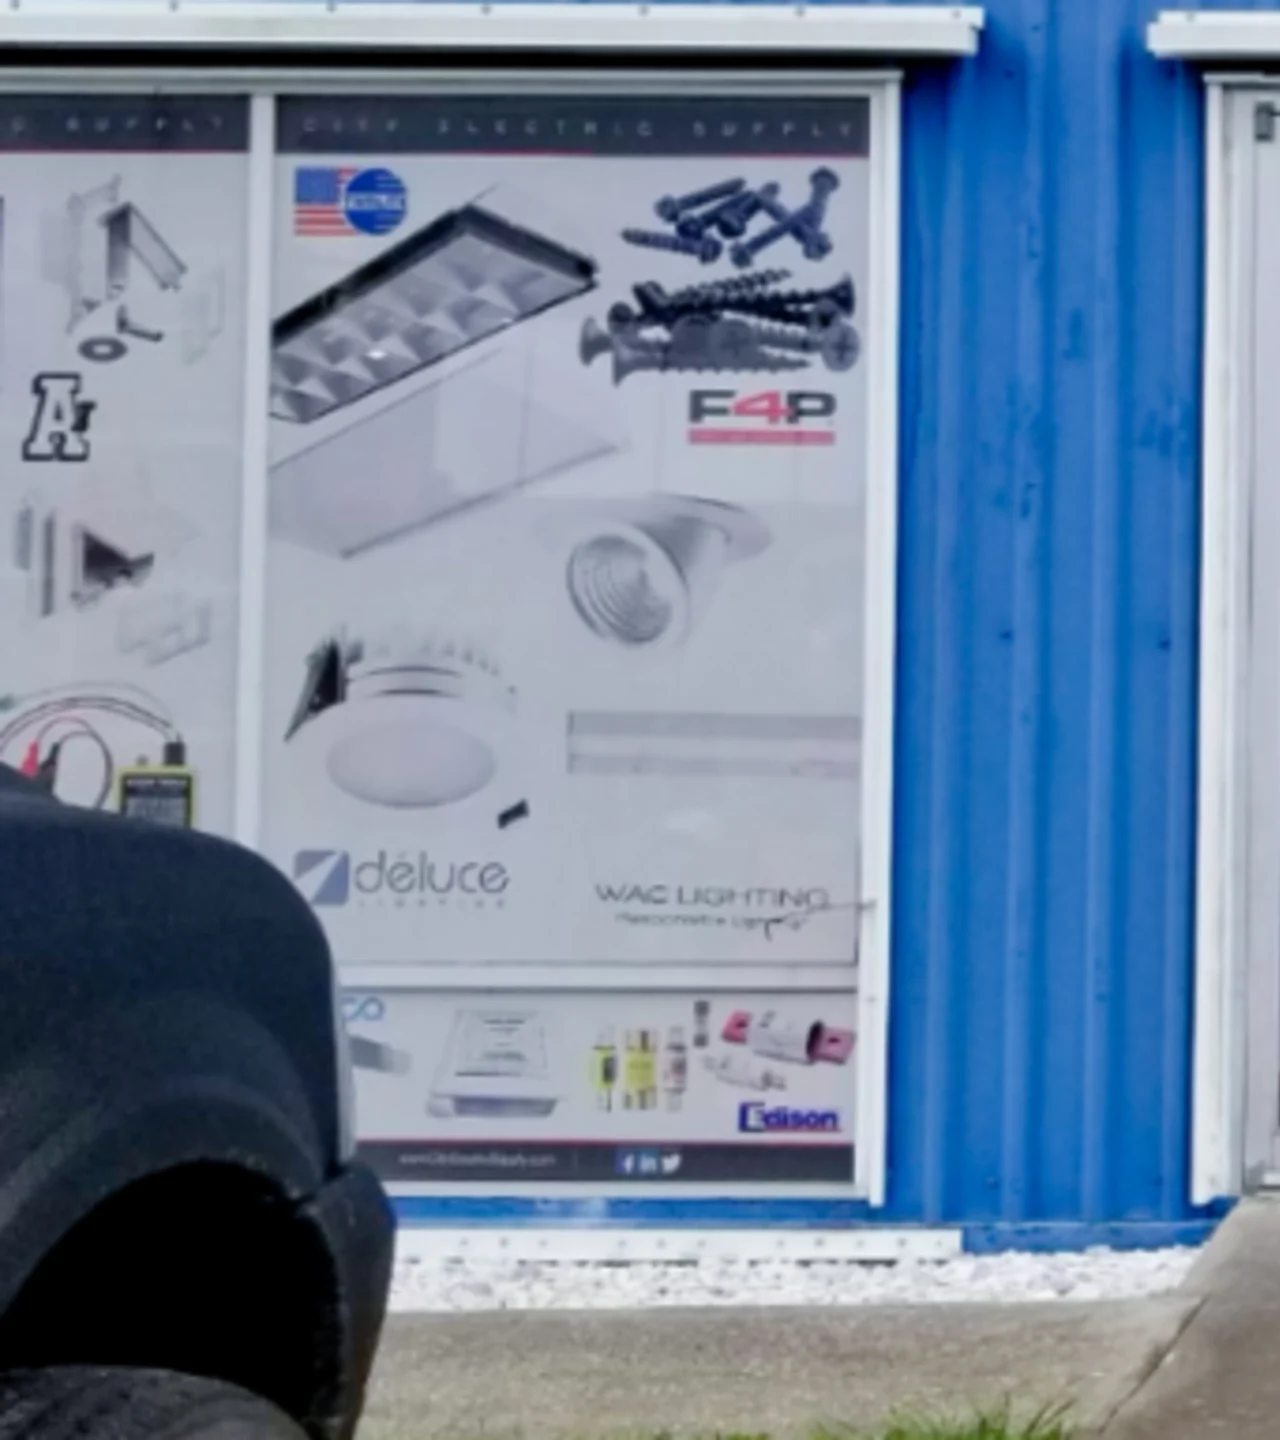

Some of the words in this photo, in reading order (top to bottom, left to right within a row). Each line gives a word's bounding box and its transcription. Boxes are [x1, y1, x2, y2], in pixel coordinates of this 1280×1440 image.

[687, 389, 837, 424] F4P
[595, 884, 669, 905] WAC
[676, 886, 831, 908] LIGHTING
[739, 1101, 841, 1132] Edison
